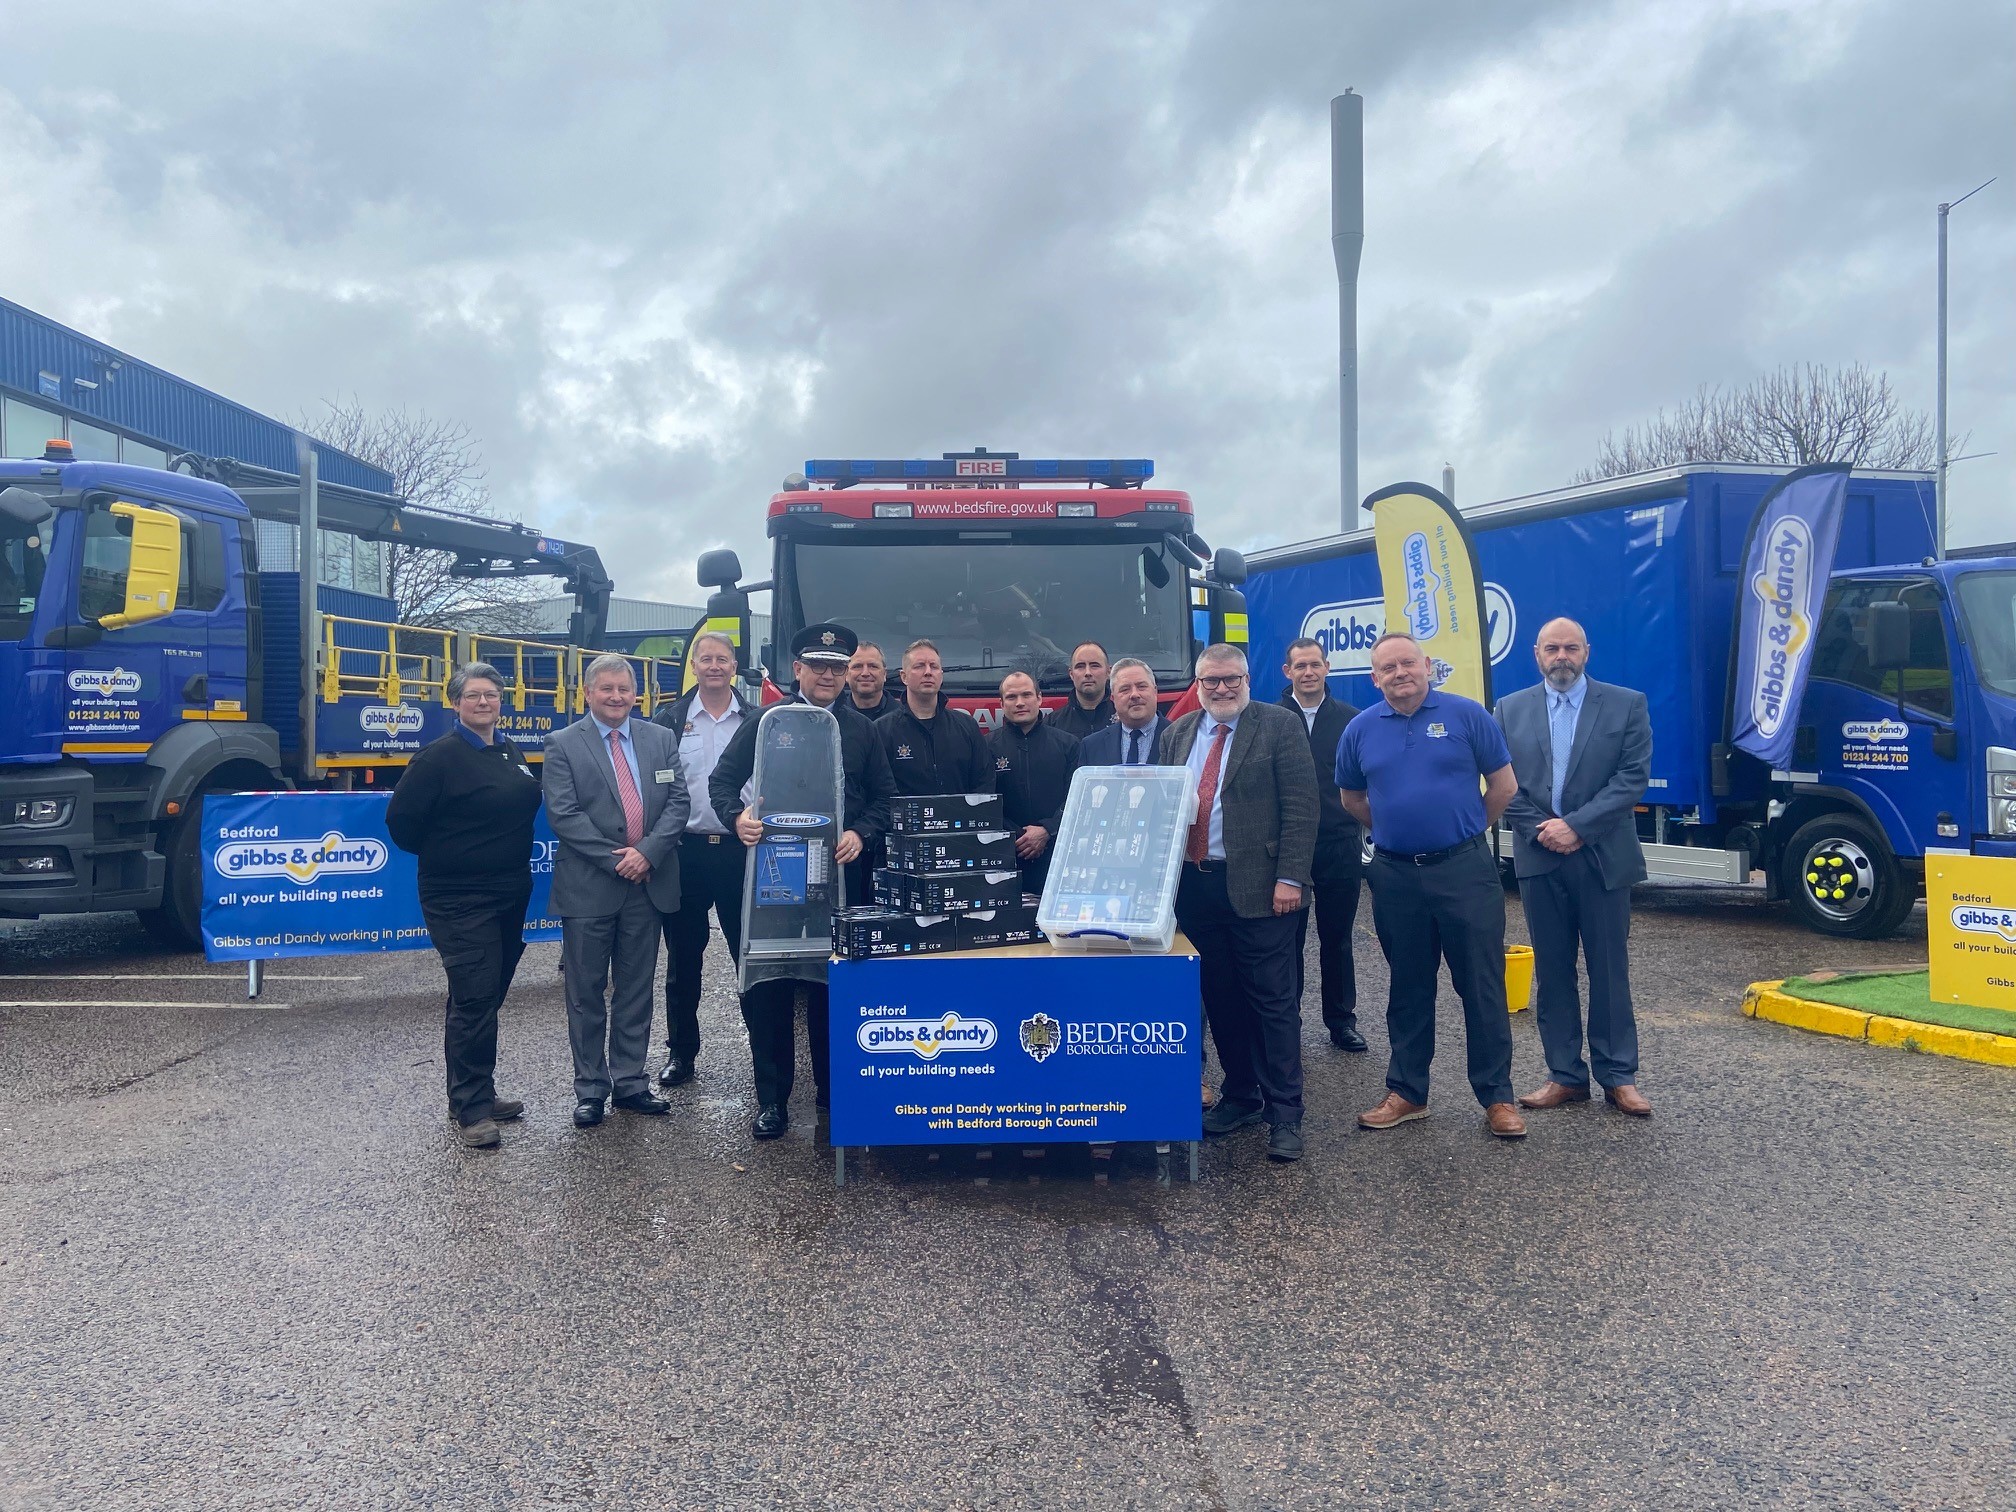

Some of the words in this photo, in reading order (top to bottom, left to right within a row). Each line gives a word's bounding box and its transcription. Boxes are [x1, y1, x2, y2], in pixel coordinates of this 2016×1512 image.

[959, 462, 1003, 474] FIRE
[917, 501, 1054, 516] www.bedsfire.gov.uk
[1770, 529, 1803, 619] dandy
[1315, 615, 1377, 658] gibbs
[1769, 623, 1791, 646] &
[163, 648, 177, 656] TGS
[74, 675, 100, 687] gibbs
[101, 676, 109, 685] &
[110, 675, 137, 688] dandy
[1760, 650, 1787, 723] gibbs
[97, 699, 119, 707] building
[69, 710, 100, 720] 01234
[104, 710, 120, 720] 244
[124, 710, 140, 720] 700
[365, 712, 387, 726] gibbs
[388, 713, 395, 723] &
[396, 712, 420, 727] dandy
[69, 723, 140, 732] www.gibbsanddandy.com
[496, 715, 513, 729] 234
[515, 716, 532, 730] 244
[535, 717, 552, 730] 700
[1847, 725, 1868, 735] gibbs
[1878, 725, 1904, 735] dandy
[370, 742, 383, 750] your
[384, 740, 404, 750] building
[405, 740, 420, 748] needs
[1843, 752, 1870, 761] 01234
[1872, 753, 1889, 762] 244
[1891, 754, 1909, 763] 700
[220, 826, 278, 838] Bedford
[229, 849, 287, 871] gibbs
[290, 848, 307, 864] &
[311, 846, 378, 866] dandy
[219, 893, 237, 905] all
[242, 894, 274, 906] your
[279, 890, 337, 903] building
[342, 886, 384, 899] needs
[1952, 893, 1991, 903] Bedford
[1960, 911, 1998, 926] gibbs
[2001, 914, 2013, 927] &
[214, 935, 251, 948] Gibbs
[256, 933, 281, 946] and
[285, 932, 326, 945] Dandy
[329, 929, 379, 942] working
[382, 928, 392, 939] in
[1954, 942, 1965, 950] all
[1969, 944, 1991, 952] your
[1987, 977, 2015, 987] Gibbs
[860, 1005, 907, 1017] Bedford
[868, 1027, 914, 1046] gibbs
[917, 1026, 931, 1041] &
[934, 1025, 988, 1044] dandy
[1066, 1022, 1187, 1044] BEDFORD
[1066, 1044, 1128, 1055] BOROUGH
[1131, 1044, 1187, 1055] COUNCIL
[860, 1065, 875, 1076] all
[878, 1067, 905, 1078] your
[908, 1064, 956, 1077] building
[960, 1063, 995, 1075] needs
[895, 1105, 927, 1115] Gibbs
[931, 1104, 952, 1114] and
[956, 1104, 992, 1116] Dandy
[996, 1103, 1042, 1115] working
[1046, 1102, 1056, 1113] in
[1060, 1101, 1127, 1114] partnership
[928, 1119, 953, 1129] with
[957, 1118, 1002, 1129] Bedford
[1006, 1118, 1052, 1130] Borough
[1056, 1117, 1098, 1127] Council
